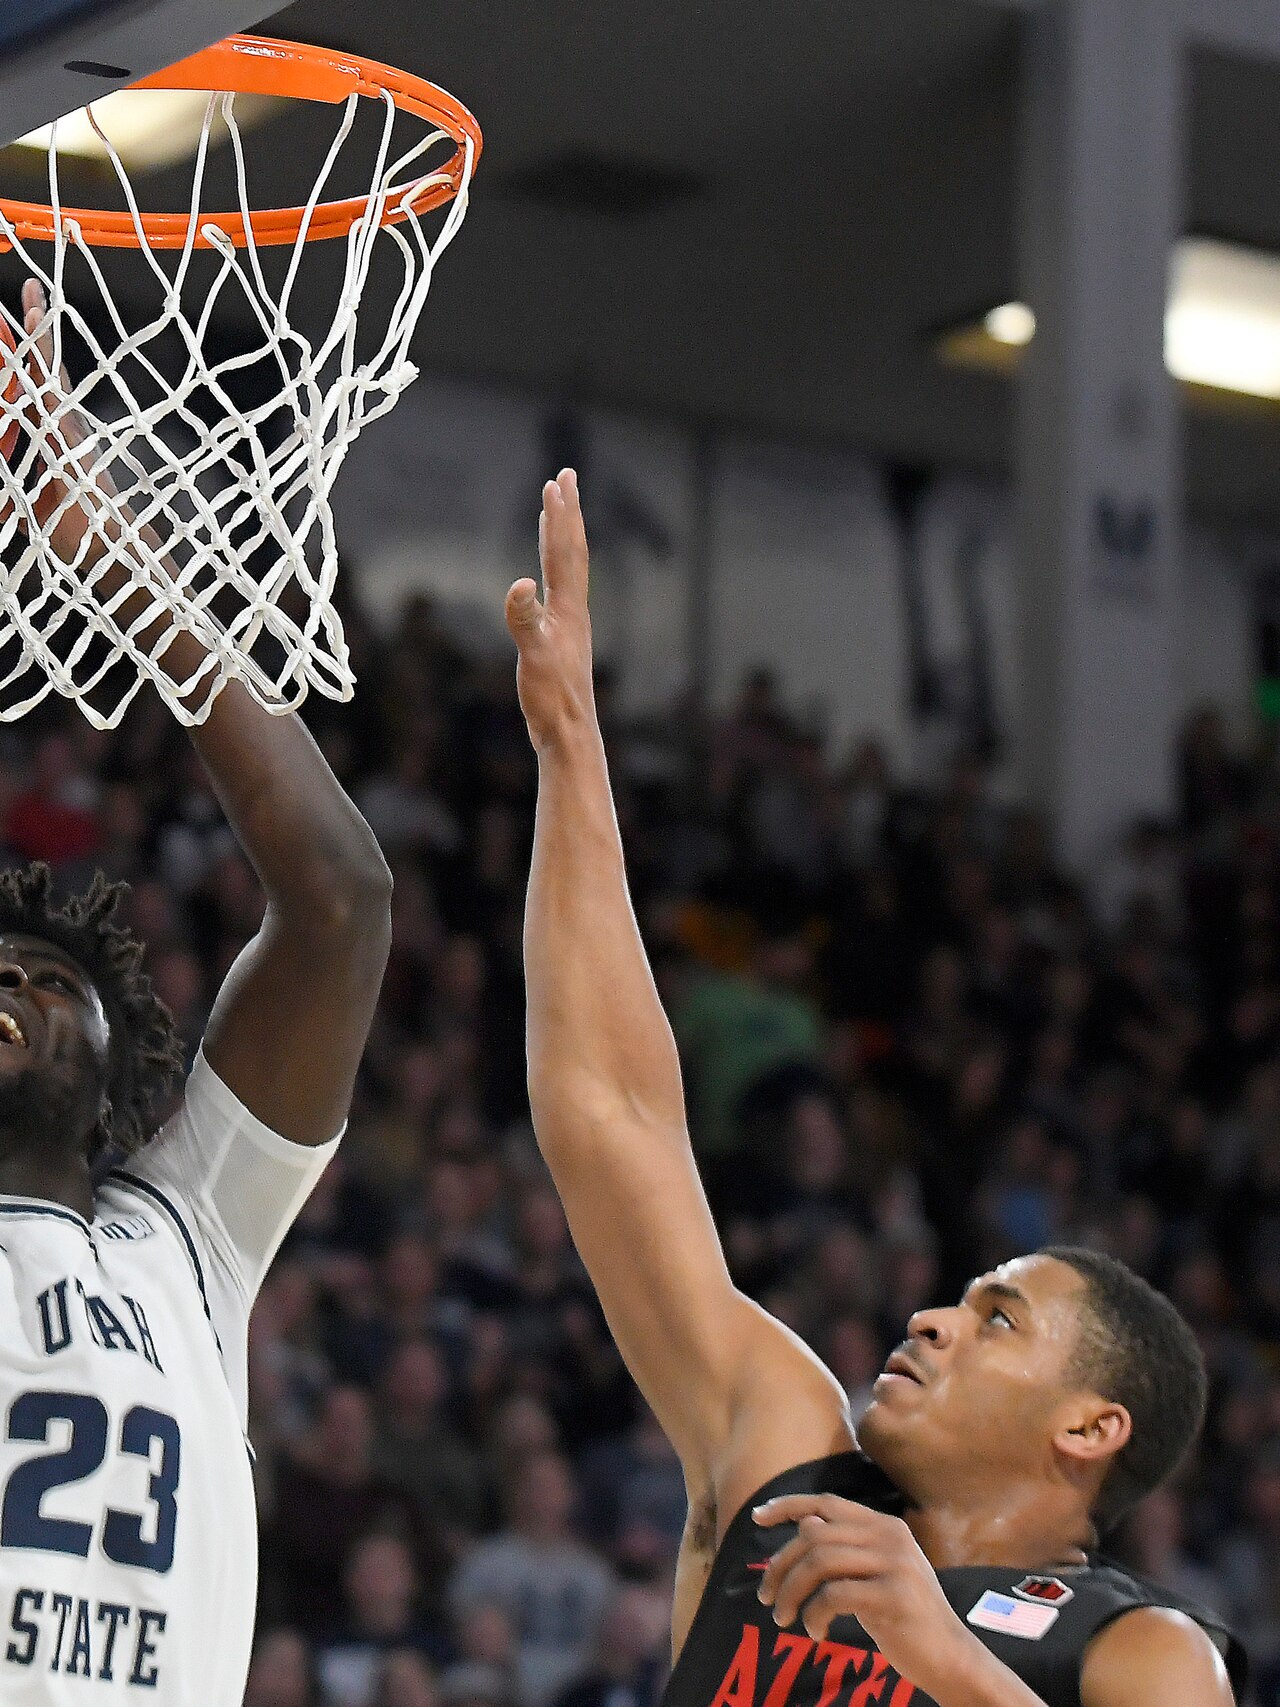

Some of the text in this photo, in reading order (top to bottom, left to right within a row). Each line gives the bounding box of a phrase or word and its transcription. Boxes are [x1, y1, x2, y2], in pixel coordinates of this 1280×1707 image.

[36, 1274, 167, 1376] UTAH
[5, 1586, 168, 1688] STATE
[710, 1623, 916, 1707] AZTE
